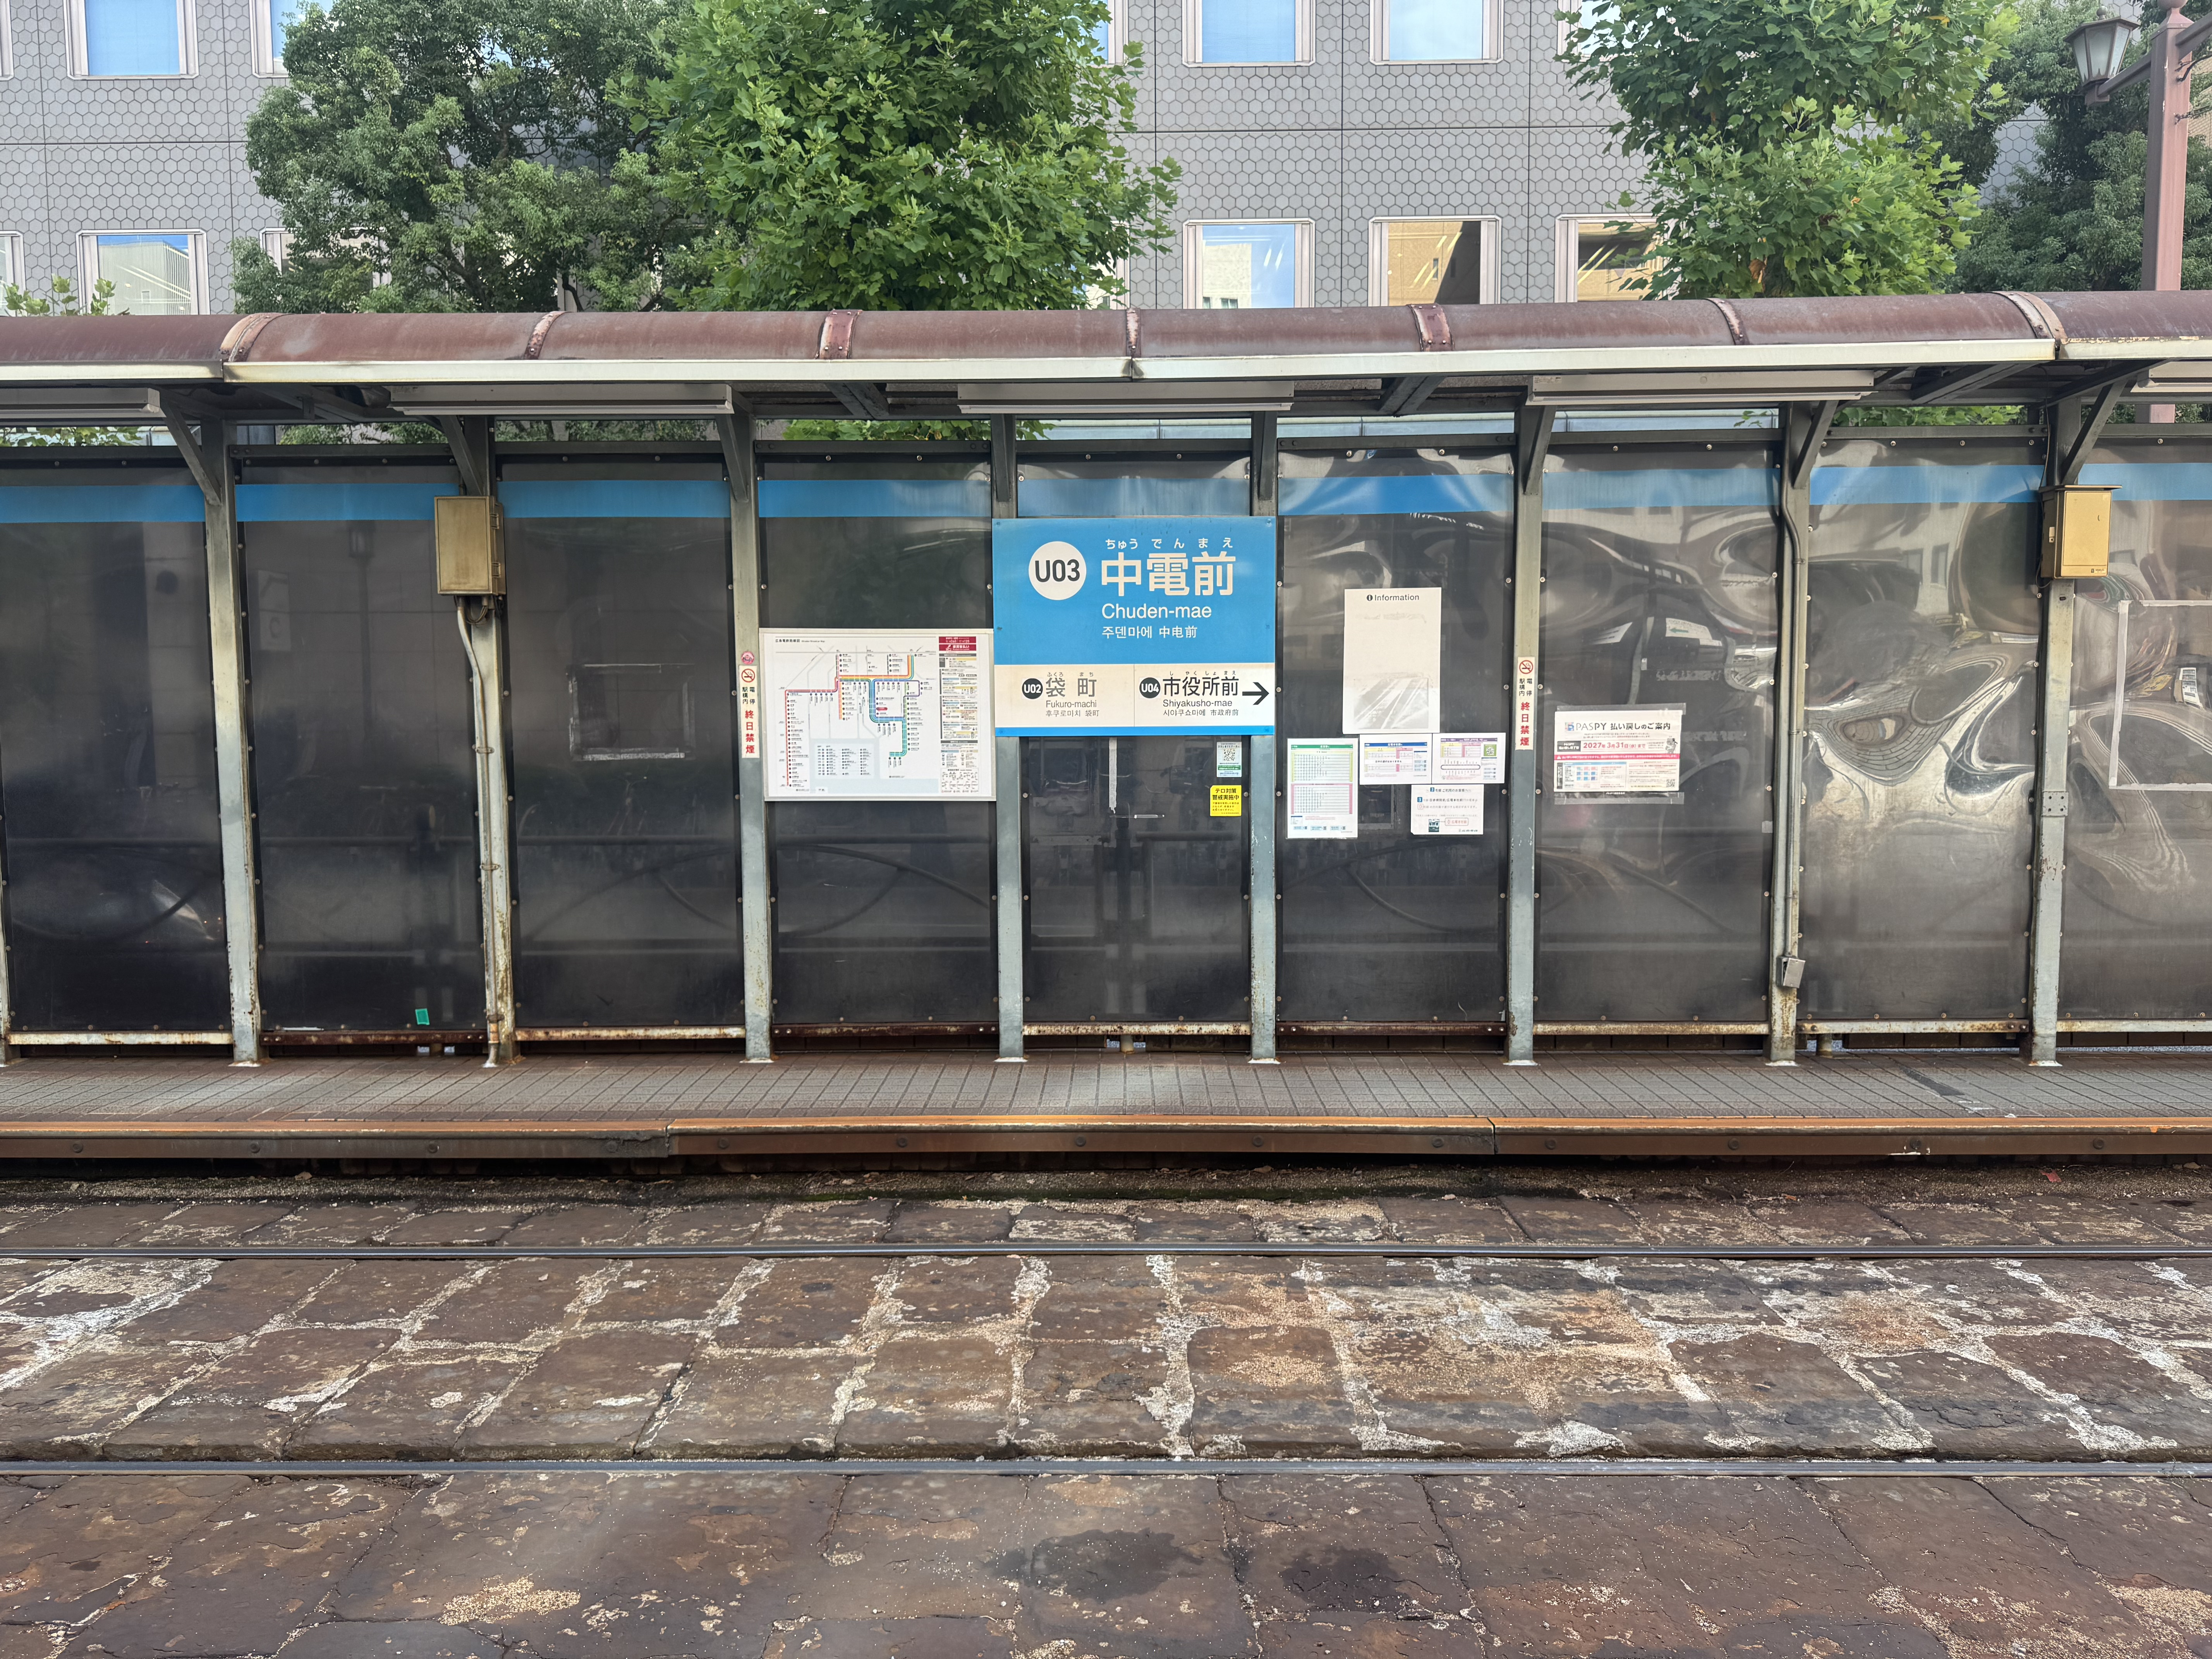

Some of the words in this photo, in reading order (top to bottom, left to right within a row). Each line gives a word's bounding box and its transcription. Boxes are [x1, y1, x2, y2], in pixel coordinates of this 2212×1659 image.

[1034, 559, 1080, 582] U03
[1101, 551, 1236, 596] 中電前
[1102, 603, 1212, 619] Chuden-mae
[1102, 626, 1152, 639] 주덴마에
[1159, 625, 1197, 638] 中电前
[1024, 684, 1041, 694] U02
[1141, 683, 1159, 693] U04
[1163, 676, 1239, 697] 市役所前
[1163, 699, 1232, 709] Shiyakusho-mae
[745, 710, 755, 754] 終日禁煙
[1520, 702, 1530, 746] 終日禁煙
